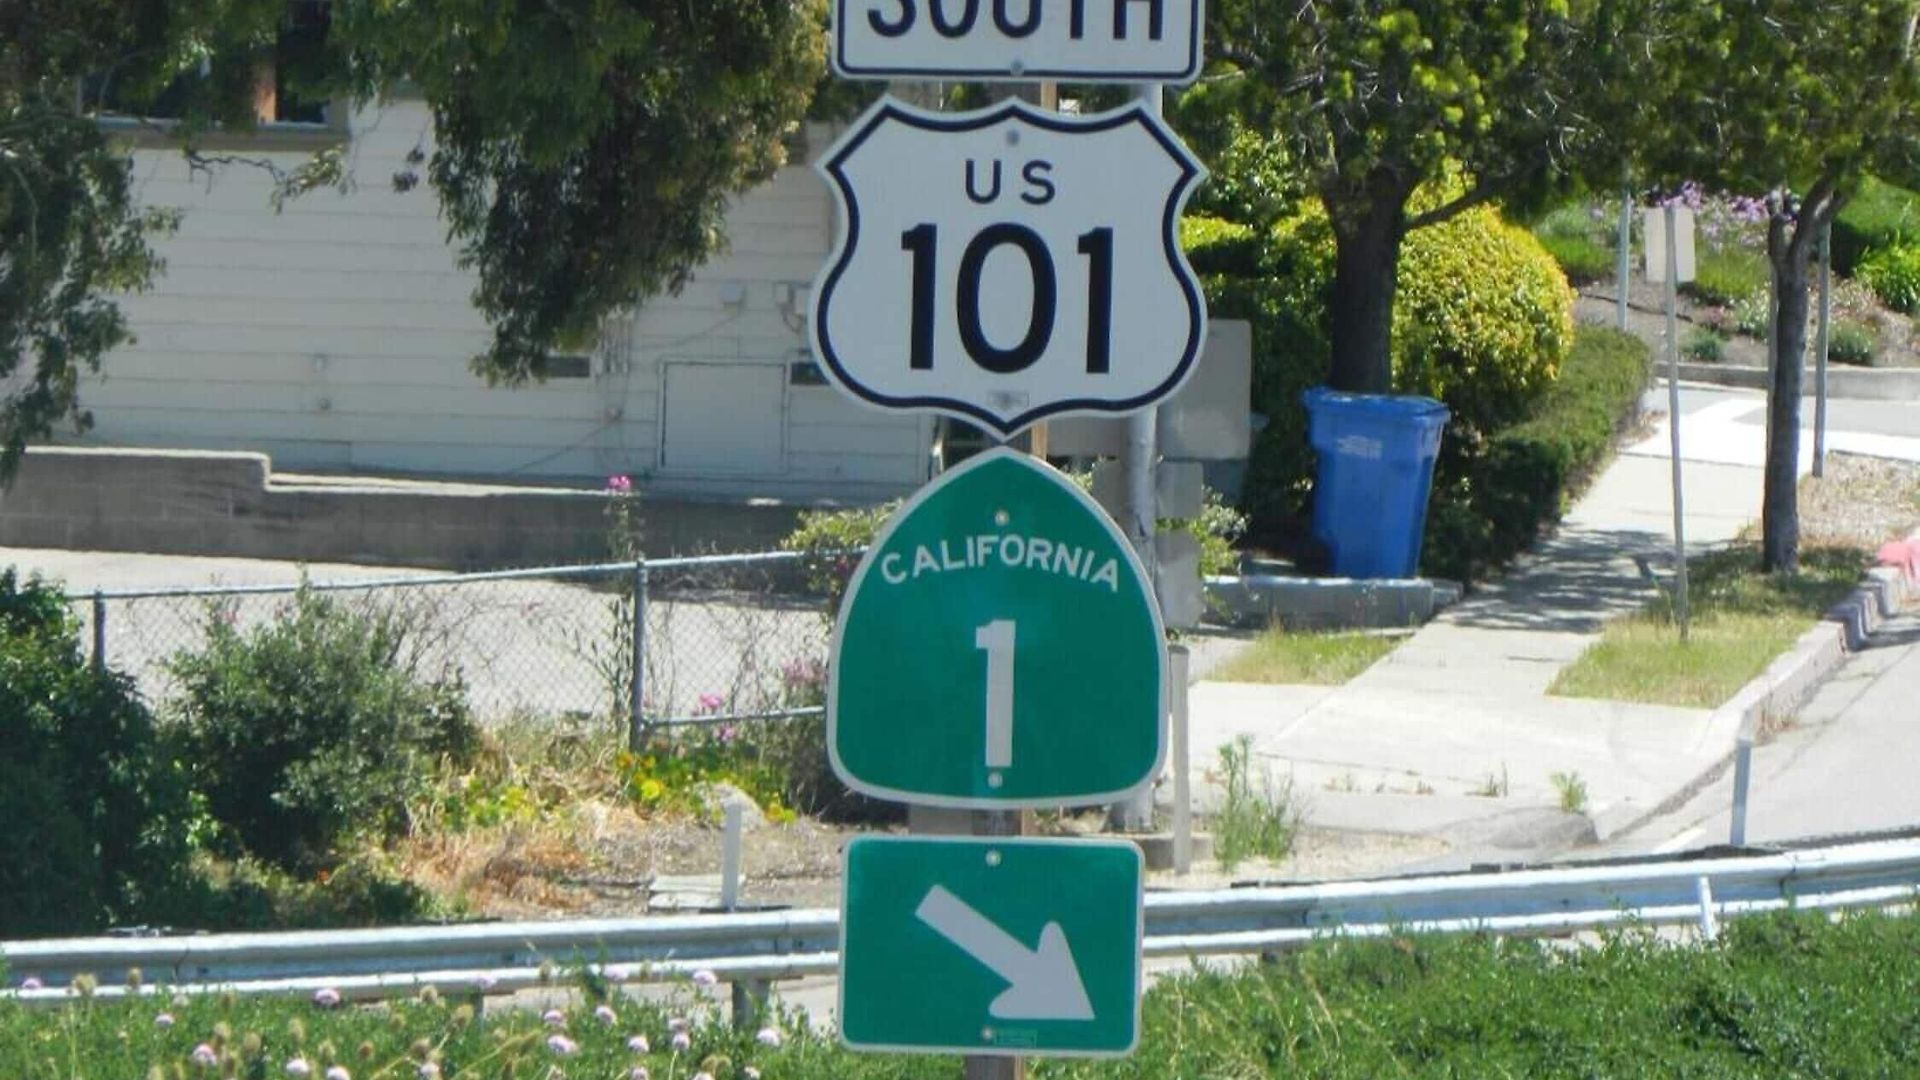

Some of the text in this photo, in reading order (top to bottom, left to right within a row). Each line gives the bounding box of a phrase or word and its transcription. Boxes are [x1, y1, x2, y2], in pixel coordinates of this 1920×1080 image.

[965, 159, 1056, 205] US
[901, 222, 1113, 374] 101
[881, 535, 1119, 592] CALIFORNIA
[975, 619, 1016, 767] 1
